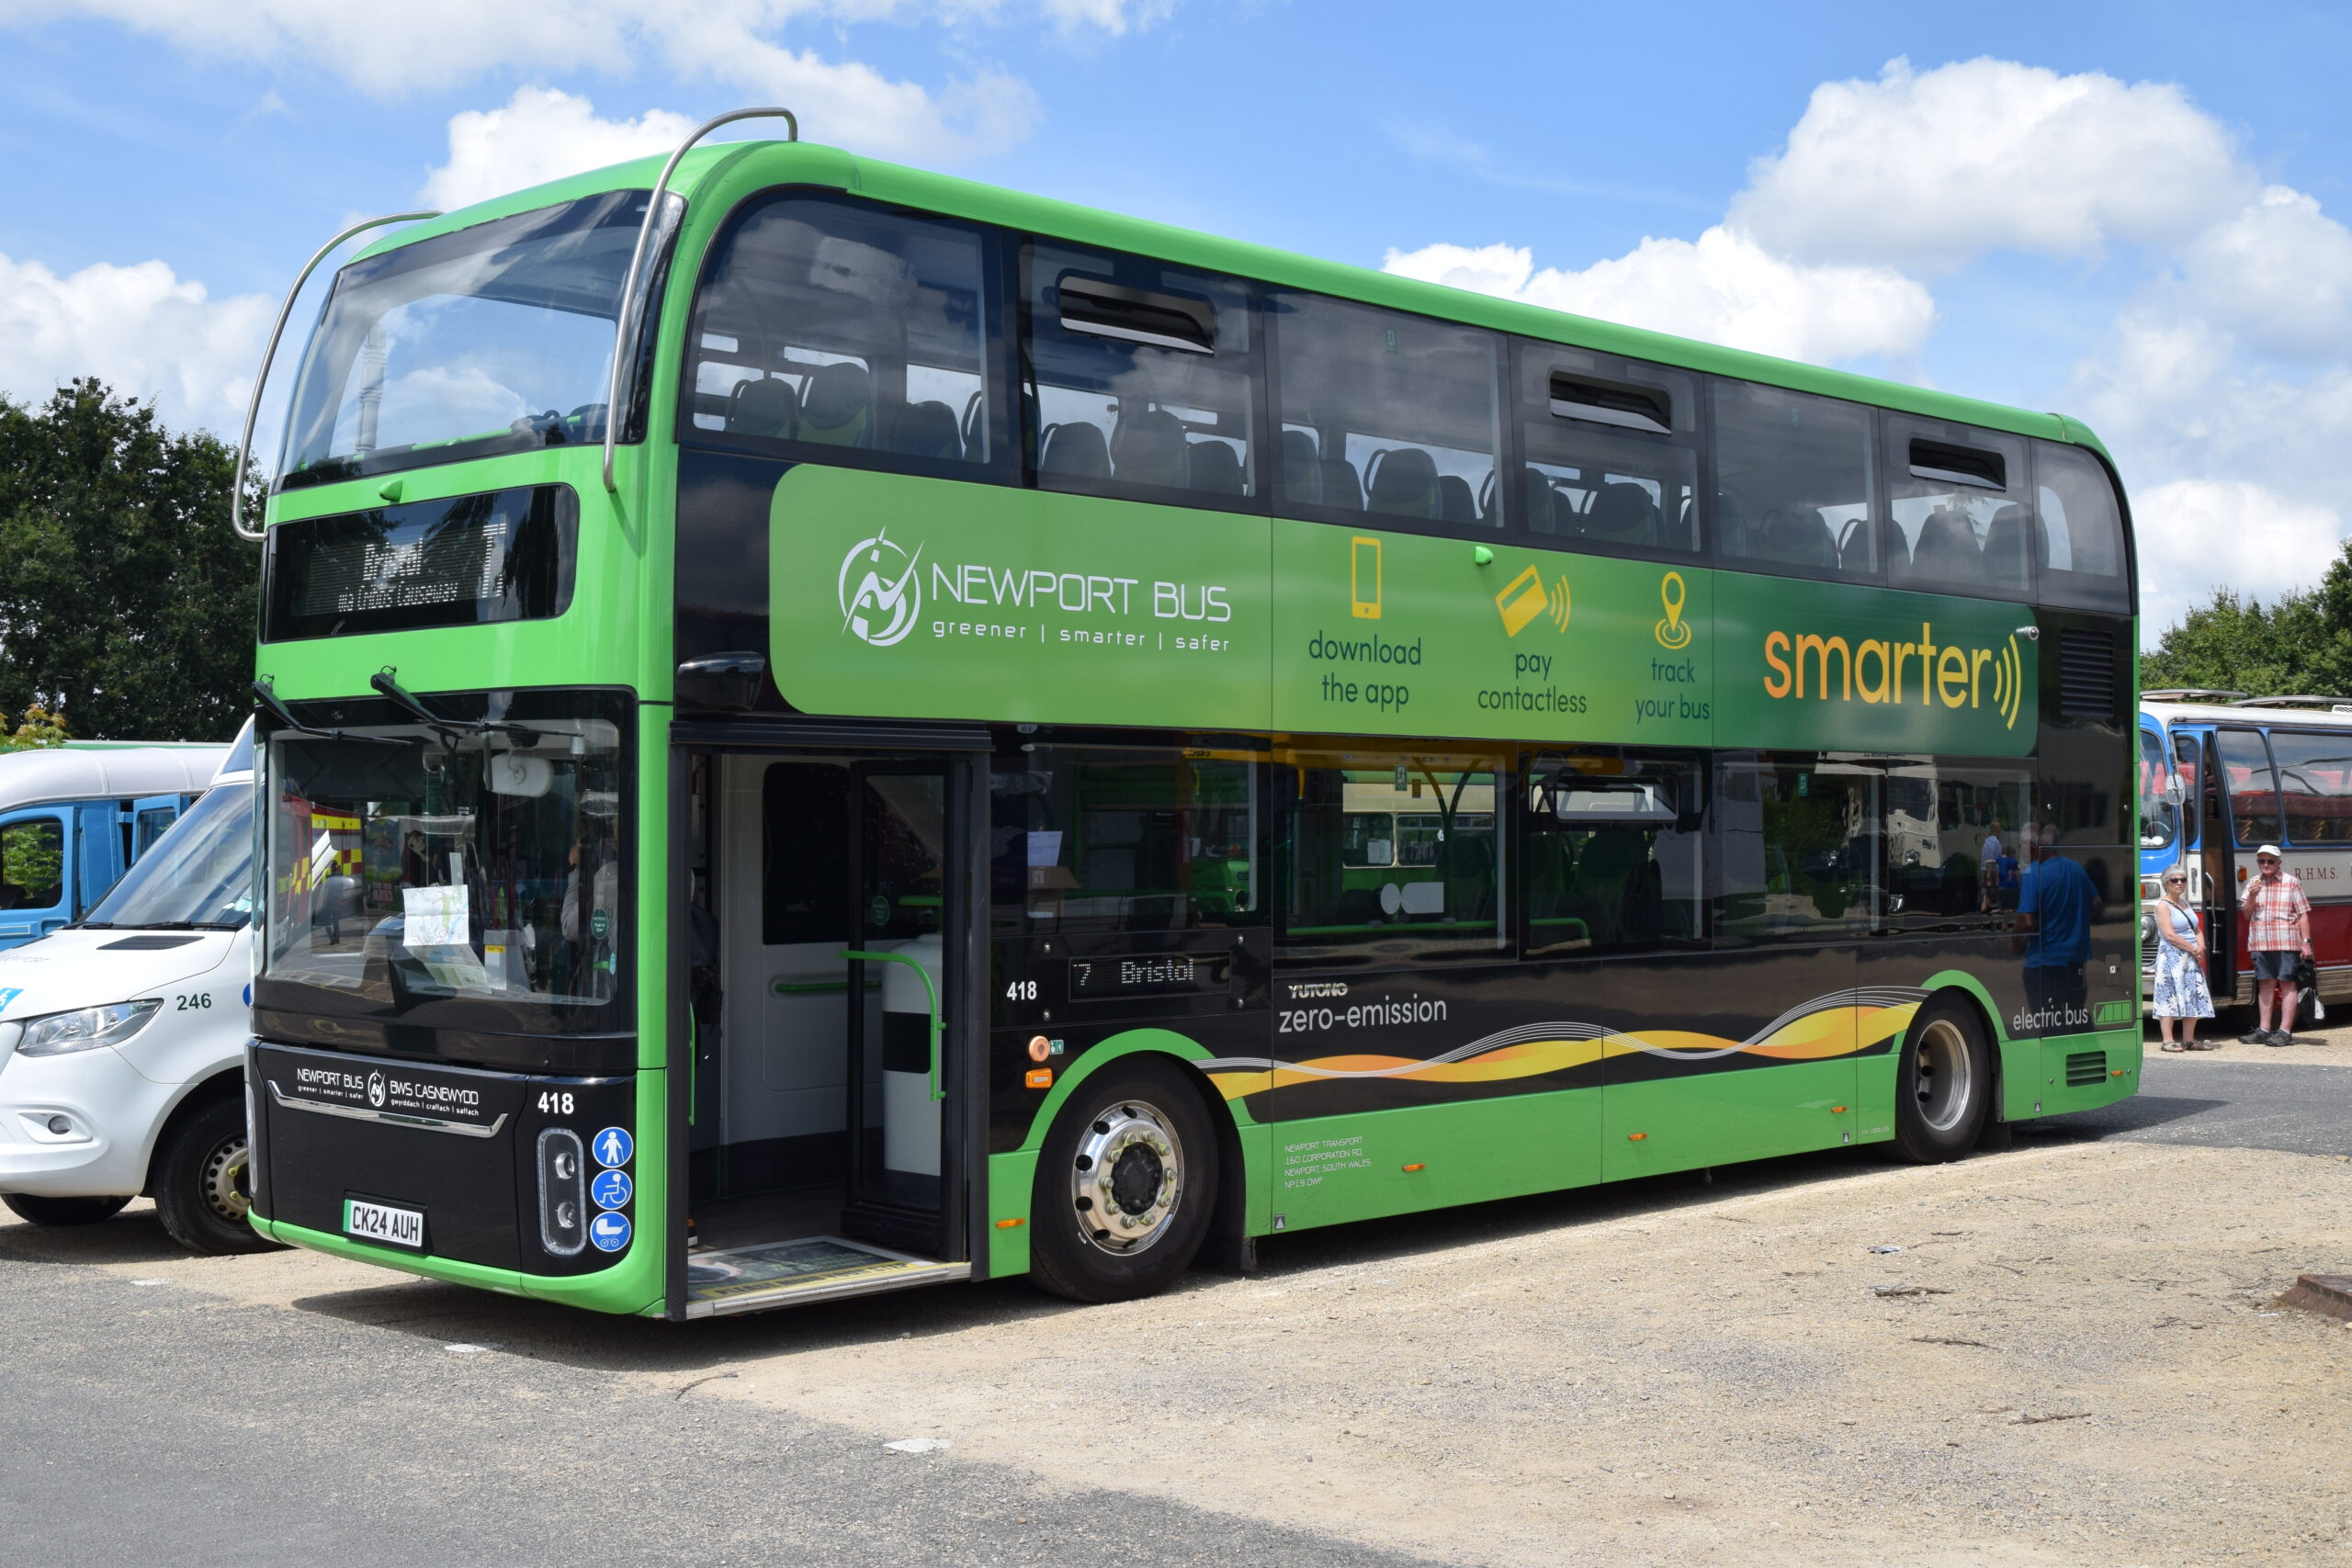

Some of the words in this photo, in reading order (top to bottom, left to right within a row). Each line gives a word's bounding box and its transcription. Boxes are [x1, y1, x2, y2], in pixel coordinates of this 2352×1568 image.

[932, 562, 1139, 615] NEWPORT
[1154, 581, 1231, 622] BUS
[933, 620, 1027, 637] greener
[1059, 628, 1146, 646] smarter
[1175, 634, 1229, 651] safer
[1308, 629, 1421, 666] download
[1515, 653, 1553, 682] pay
[1651, 657, 1695, 684] track
[1763, 621, 1992, 708] smarter
[1321, 671, 1359, 702] the
[1365, 682, 1409, 713] app
[1477, 685, 1587, 713] contactless
[1634, 695, 1677, 724] your
[1679, 693, 1710, 720] bus
[1072, 964, 1091, 986] 7
[1122, 959, 1193, 984] Bristol
[175, 992, 212, 1010] 246
[1006, 980, 1037, 1000] 418
[1288, 982, 1349, 998] YUTONG
[1279, 993, 1447, 1033] zero-emission
[2013, 1005, 2062, 1031] electric
[2065, 1002, 2088, 1026] bus
[297, 1067, 341, 1086] NEWPORT
[344, 1074, 364, 1089] BUS
[322, 1089, 344, 1097] smarter
[390, 1080, 413, 1096] BWS
[414, 1083, 479, 1105] CASNEWYDD
[537, 1091, 575, 1114] 418
[1285, 1141, 1320, 1153] NEWPORT
[1322, 1136, 1363, 1148] TRANSPORT
[1303, 1149, 1351, 1163] CORPORATION
[1322, 1161, 1346, 1172] SOUTH
[1349, 1158, 1372, 1168] WALES
[1285, 1179, 1306, 1190] NP19
[353, 1205, 388, 1235] CK24
[391, 1213, 420, 1242] AUH
